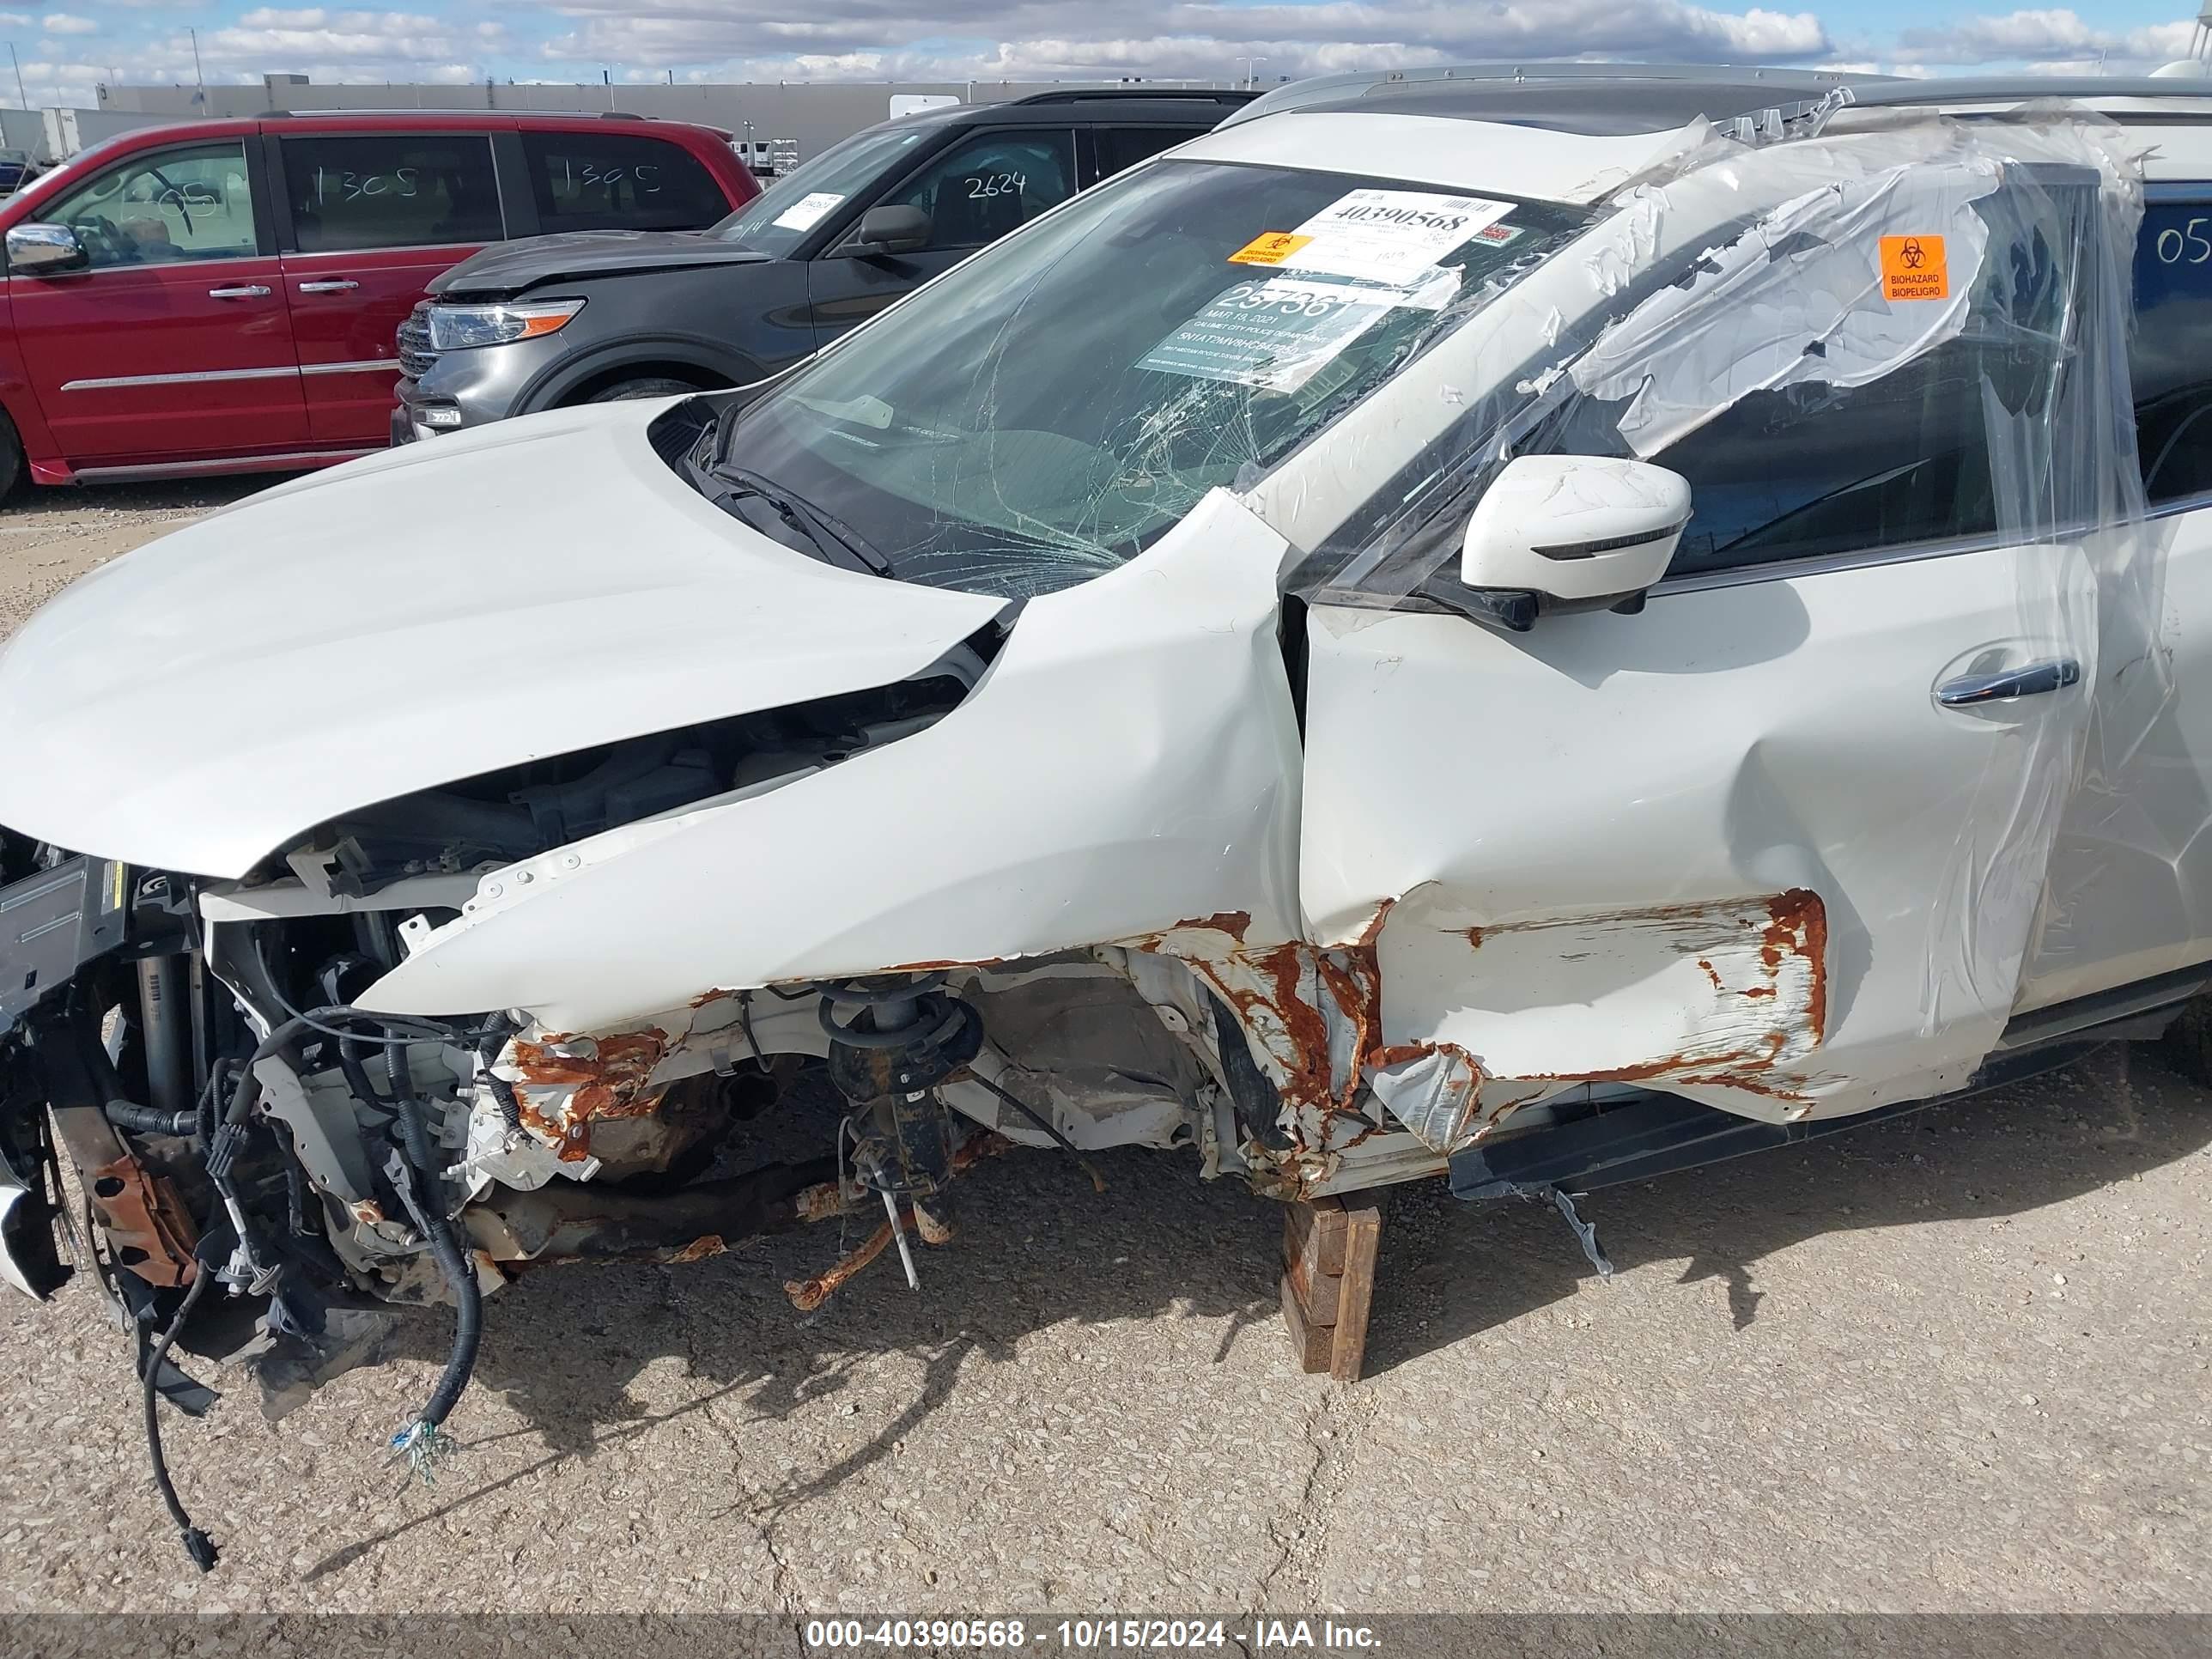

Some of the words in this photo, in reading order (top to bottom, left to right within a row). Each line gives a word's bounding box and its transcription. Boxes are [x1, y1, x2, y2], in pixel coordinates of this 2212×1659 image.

[566, 159, 660, 191] 1305
[319, 166, 419, 206] 1305
[964, 171, 1027, 199] 2624
[1334, 205, 1469, 232] 40390568
[1891, 274, 1939, 284] BIOHAZARD
[1892, 286, 1941, 297] BIOPELIGRO
[1249, 314, 1279, 324] 2021
[1245, 326, 1275, 336] POLICE
